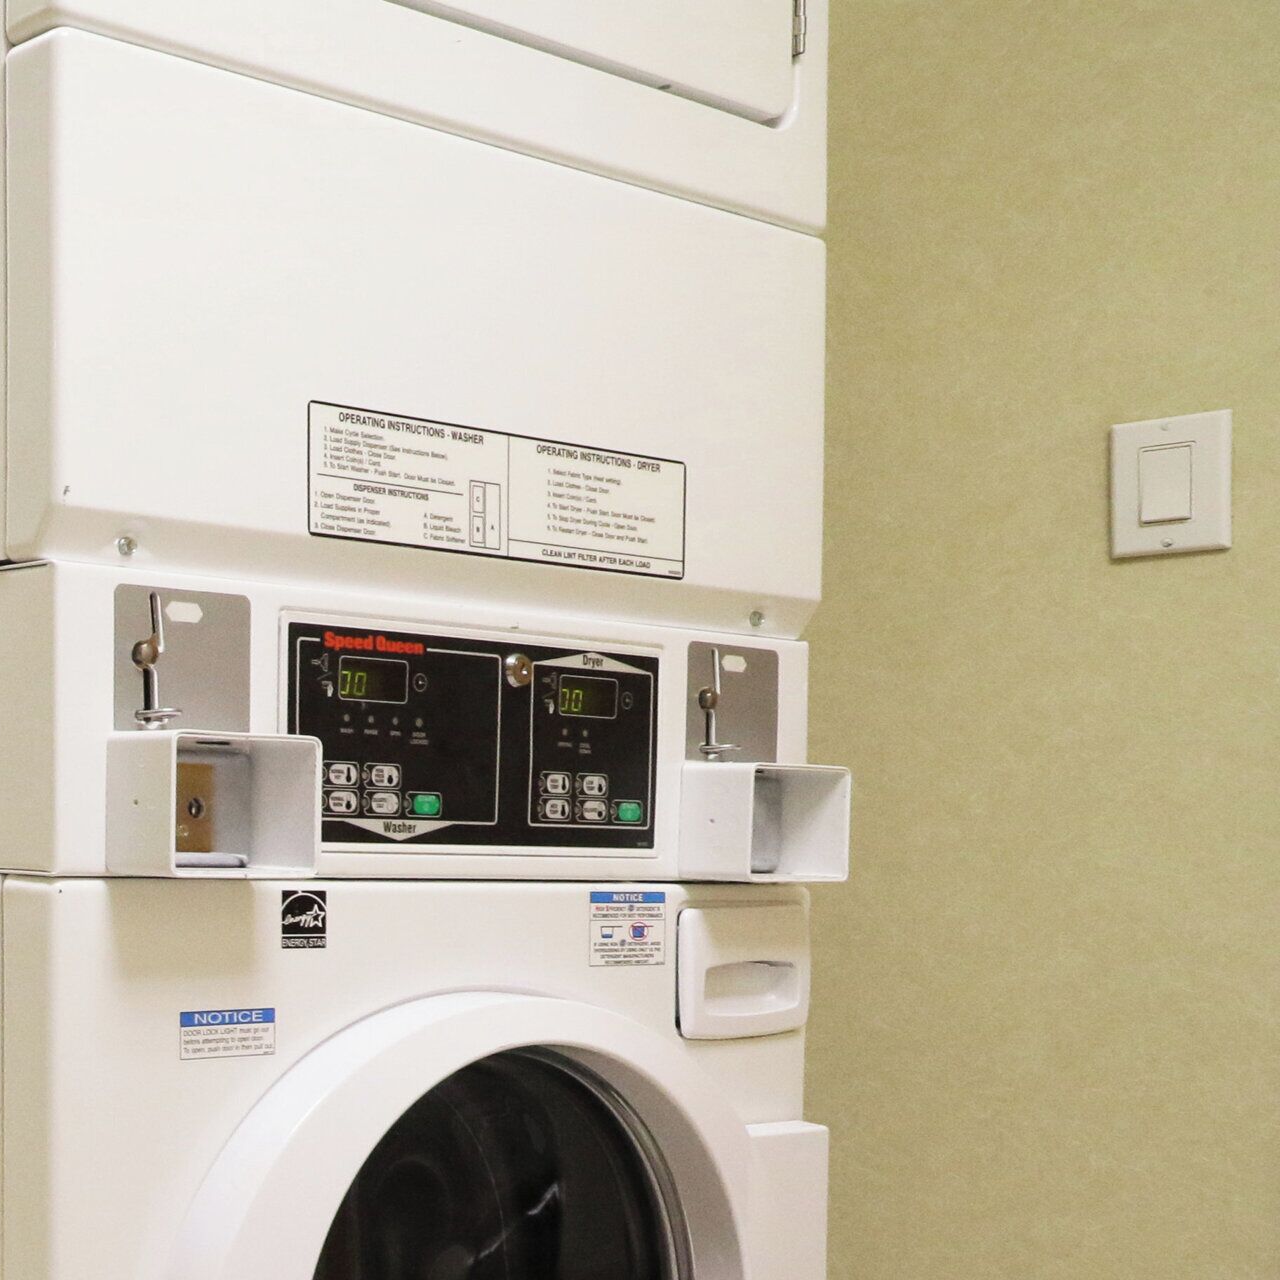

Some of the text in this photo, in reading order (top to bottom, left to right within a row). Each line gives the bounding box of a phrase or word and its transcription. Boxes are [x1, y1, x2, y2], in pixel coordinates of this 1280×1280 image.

[339, 412, 385, 429] OPERATING
[388, 420, 445, 439] INSTRUCTIONS
[451, 431, 484, 444] WASHER
[536, 444, 578, 460] OPERATING
[580, 452, 631, 468] INSTRUCTIONS
[637, 460, 661, 472] DRYER
[353, 484, 429, 501] DISPENSER INSTRUCTIONS
[541, 549, 562, 558] CLEAN
[577, 553, 597, 562] FILTER
[599, 556, 617, 565] AFTER
[618, 558, 634, 567] EACH
[635, 560, 651, 569] LOAD
[324, 631, 425, 655] Speed Queen
[583, 654, 604, 668] Dryer
[383, 821, 416, 833] Washer
[612, 893, 644, 901] NOTICE
[282, 938, 326, 948] ENERGY STAR
[194, 1011, 263, 1024] NOTICE
